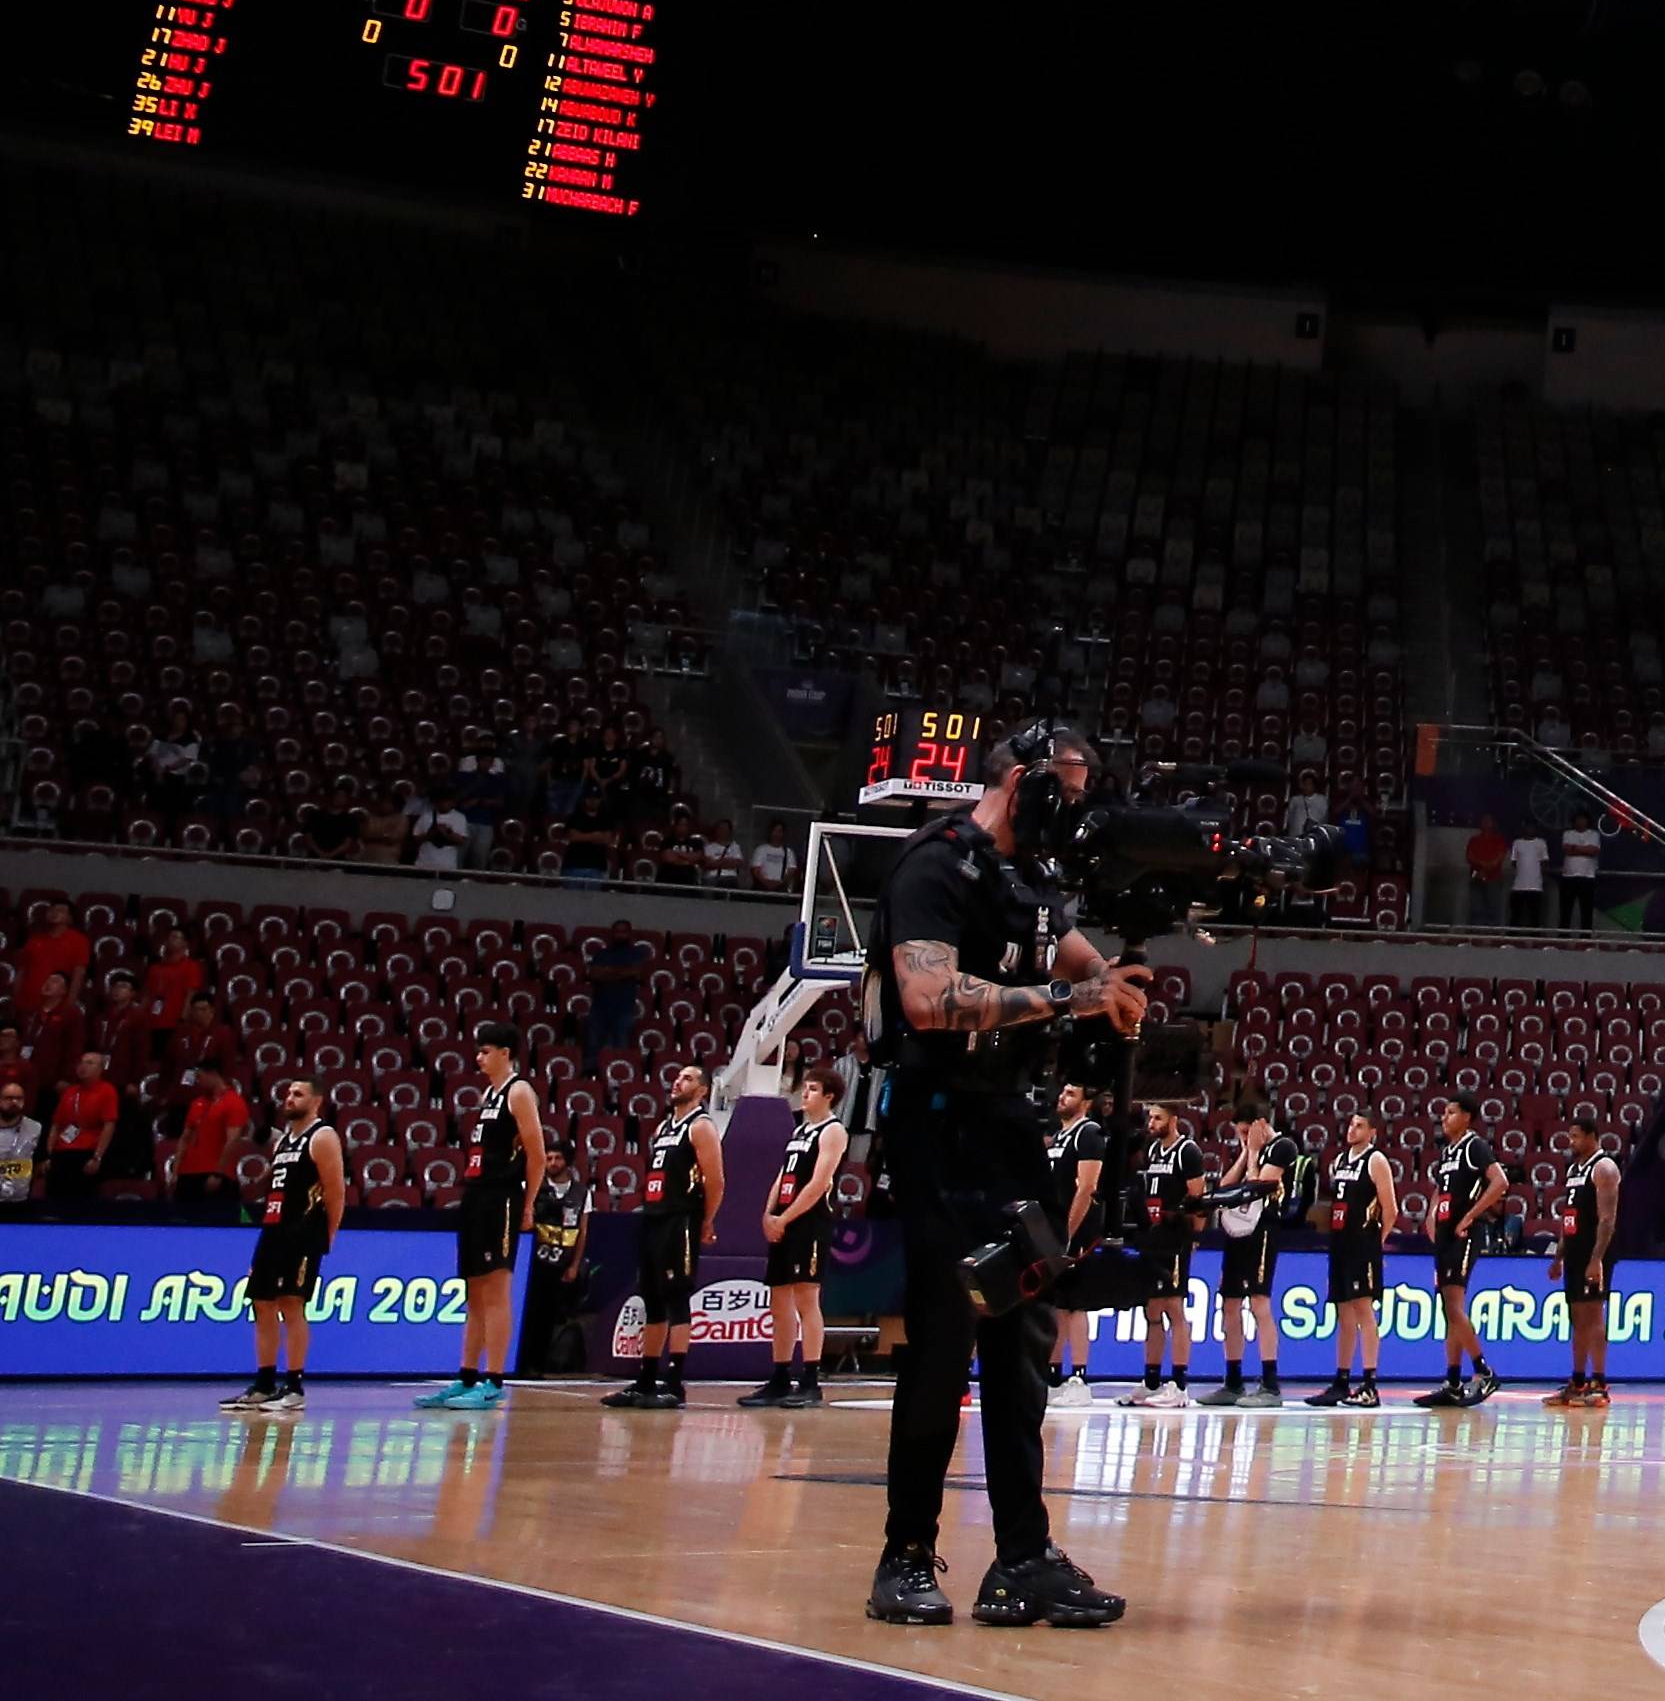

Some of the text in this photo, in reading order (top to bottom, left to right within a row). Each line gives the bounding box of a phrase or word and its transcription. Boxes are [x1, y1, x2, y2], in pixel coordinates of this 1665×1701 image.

[156, 4, 176, 20] 11
[491, 5, 519, 38] 0
[560, 10, 571, 27] 5
[631, 23, 643, 39] F
[642, 4, 655, 21] A
[152, 27, 172, 44] 17
[362, 19, 382, 44] 0
[560, 32, 569, 47] 7
[141, 48, 169, 67] 21
[498, 44, 518, 69] 0
[547, 53, 566, 69] 11
[633, 67, 644, 84] Y
[137, 71, 162, 90] 26
[544, 75, 656, 108] 12 Y
[132, 94, 159, 113] 35
[157, 98, 179, 117] LI
[540, 97, 559, 113] 14
[127, 117, 155, 136] 39
[154, 122, 184, 142] LEI
[537, 118, 640, 150] 17 ZEID KILANI
[528, 139, 616, 168] 21 H
[524, 161, 549, 179] 22
[521, 182, 546, 200] 31
[627, 200, 640, 216] F
[866, 745, 892, 787] 24
[910, 741, 968, 783] 24
[925, 781, 973, 794] TISSOT
[1337, 1181, 1346, 1199] 5
[140, 1270, 468, 1324] ARAIA 202
[702, 1289, 770, 1312] 百岁山
[1471, 1285, 1653, 1341] ARAIA
